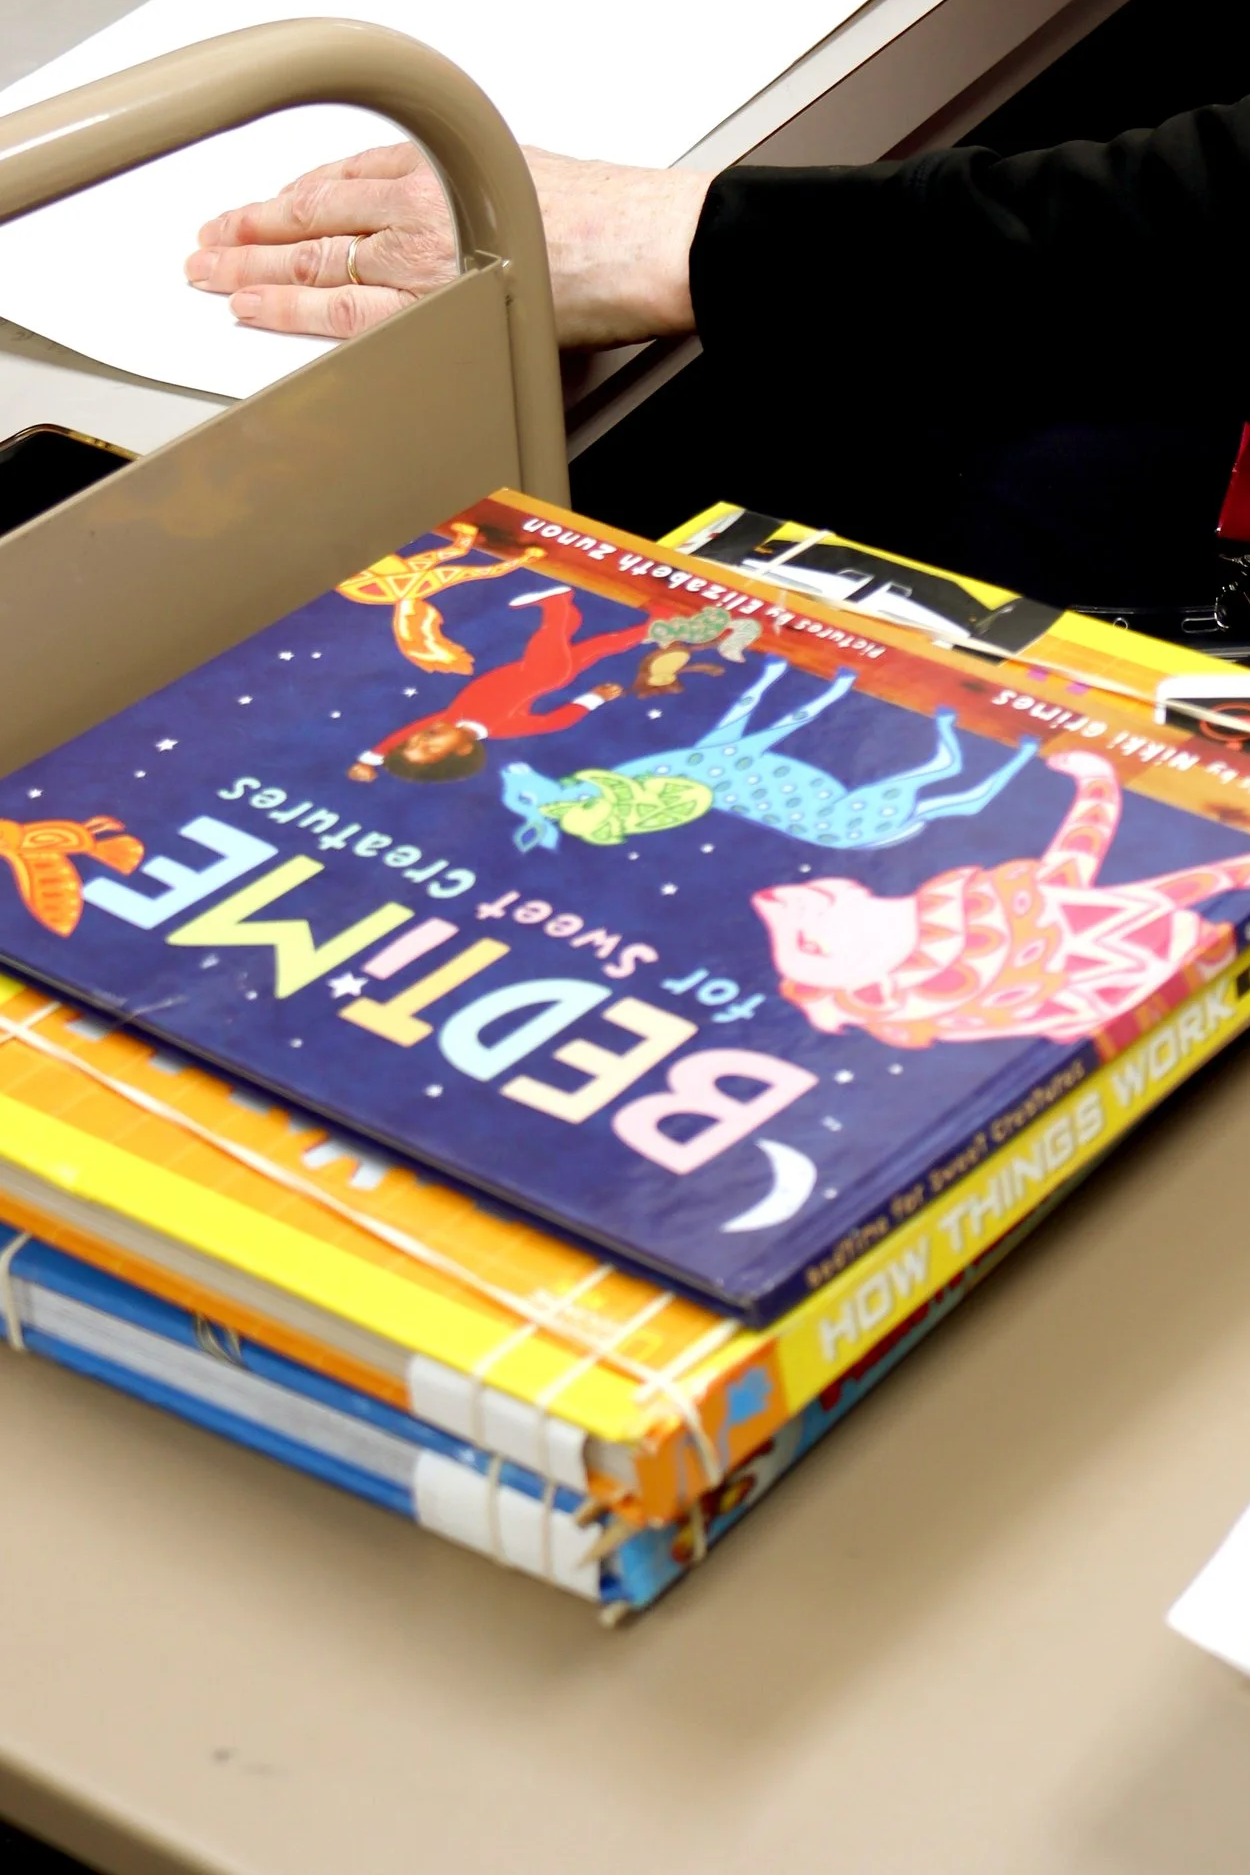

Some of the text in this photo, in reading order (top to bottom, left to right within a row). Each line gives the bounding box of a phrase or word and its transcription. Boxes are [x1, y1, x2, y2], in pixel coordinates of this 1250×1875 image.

[523, 516, 887, 660] Pictures by Elizabeth Zunon
[989, 687, 1109, 739] Grimes
[1105, 729, 1200, 772] Nikki
[1204, 758, 1241, 786] by
[216, 776, 767, 1023] for Sweet Creatures
[818, 979, 1238, 1363] HOW THINGS WORK
